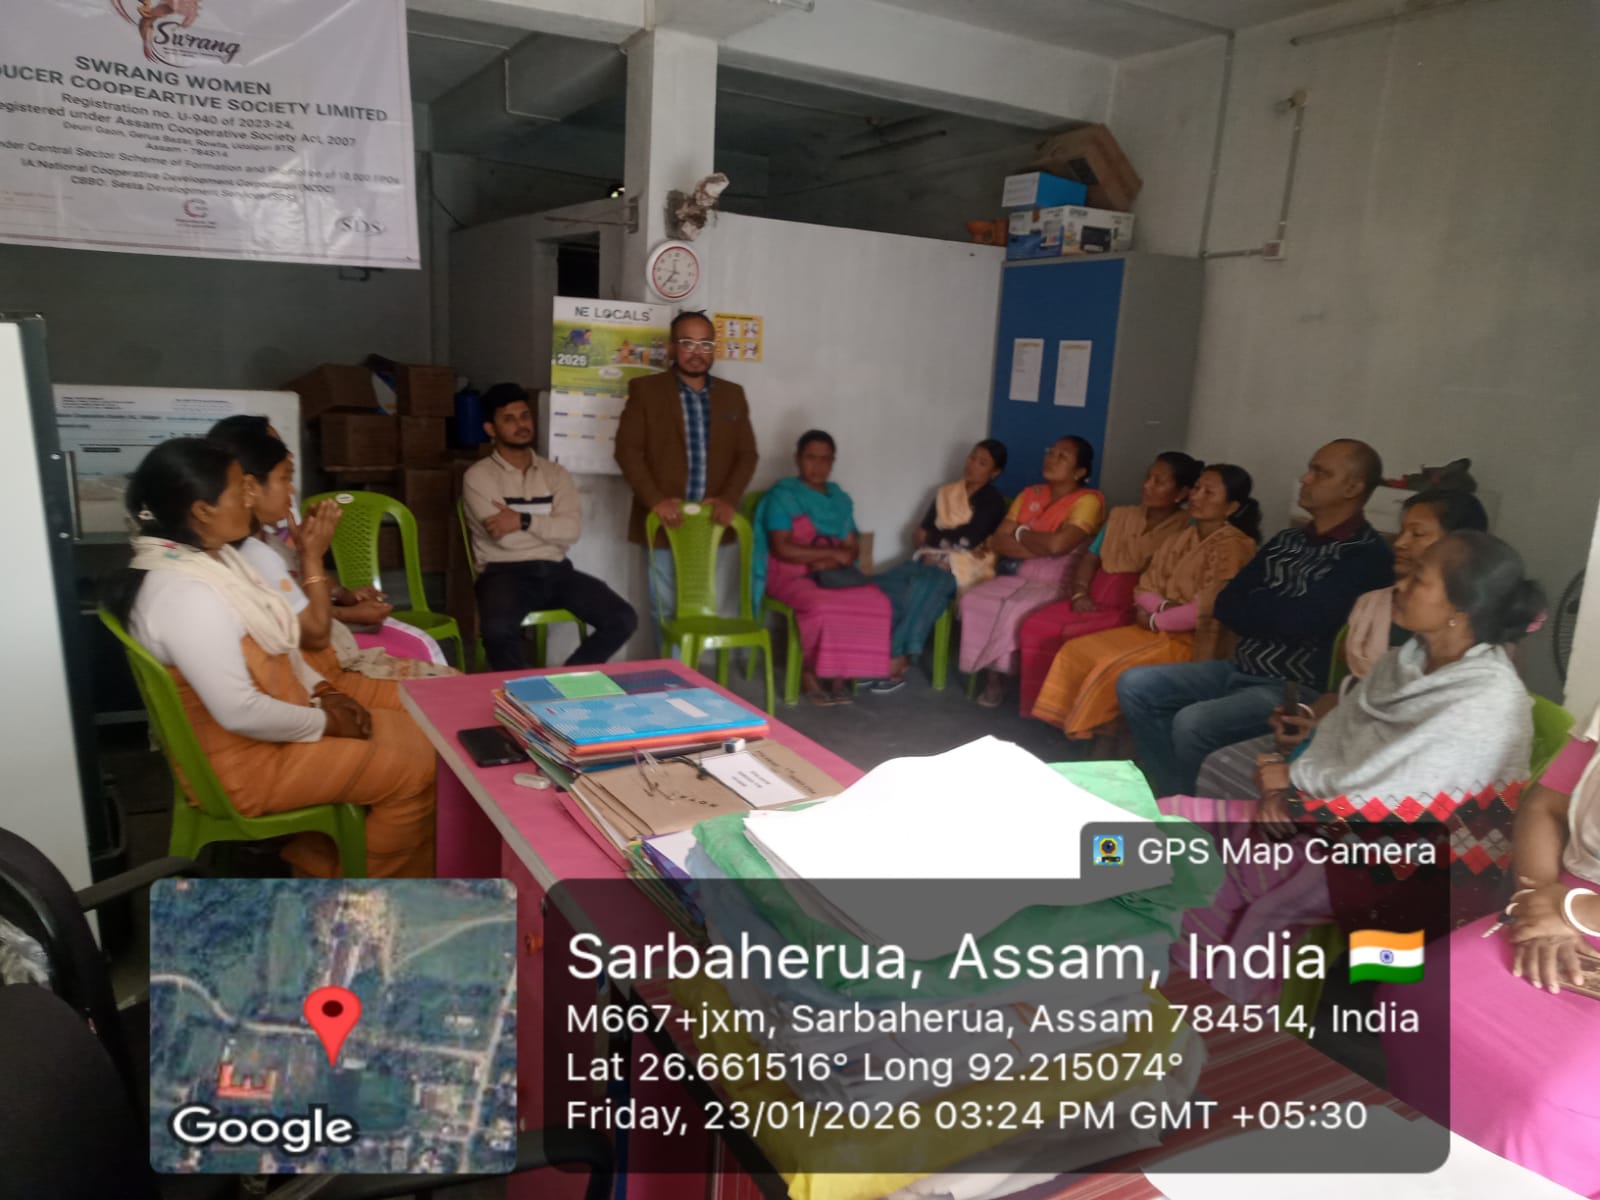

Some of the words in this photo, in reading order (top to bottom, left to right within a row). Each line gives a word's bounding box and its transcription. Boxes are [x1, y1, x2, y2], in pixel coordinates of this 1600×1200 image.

[75, 55, 179, 86] SWRANG
[185, 74, 272, 95] WOMEN
[0, 64, 64, 86] UCER
[70, 75, 222, 109] COOPEARTIVE
[228, 98, 310, 114] SOCIETY
[316, 103, 388, 121] LIMITED
[61, 93, 149, 115] Registration
[152, 109, 174, 119] no.
[177, 111, 218, 125] U-940
[221, 117, 236, 126] of
[69, 109, 111, 122] under
[115, 115, 164, 131] Assam
[167, 122, 248, 140] Cooperative
[250, 130, 297, 143] Society
[327, 136, 357, 146] 2007
[27, 142, 73, 155] Central
[75, 147, 116, 160] Sector
[118, 151, 168, 166] Scheme
[145, 142, 181, 153] Assam
[575, 306, 590, 318] NE
[594, 307, 651, 322] LOCALS
